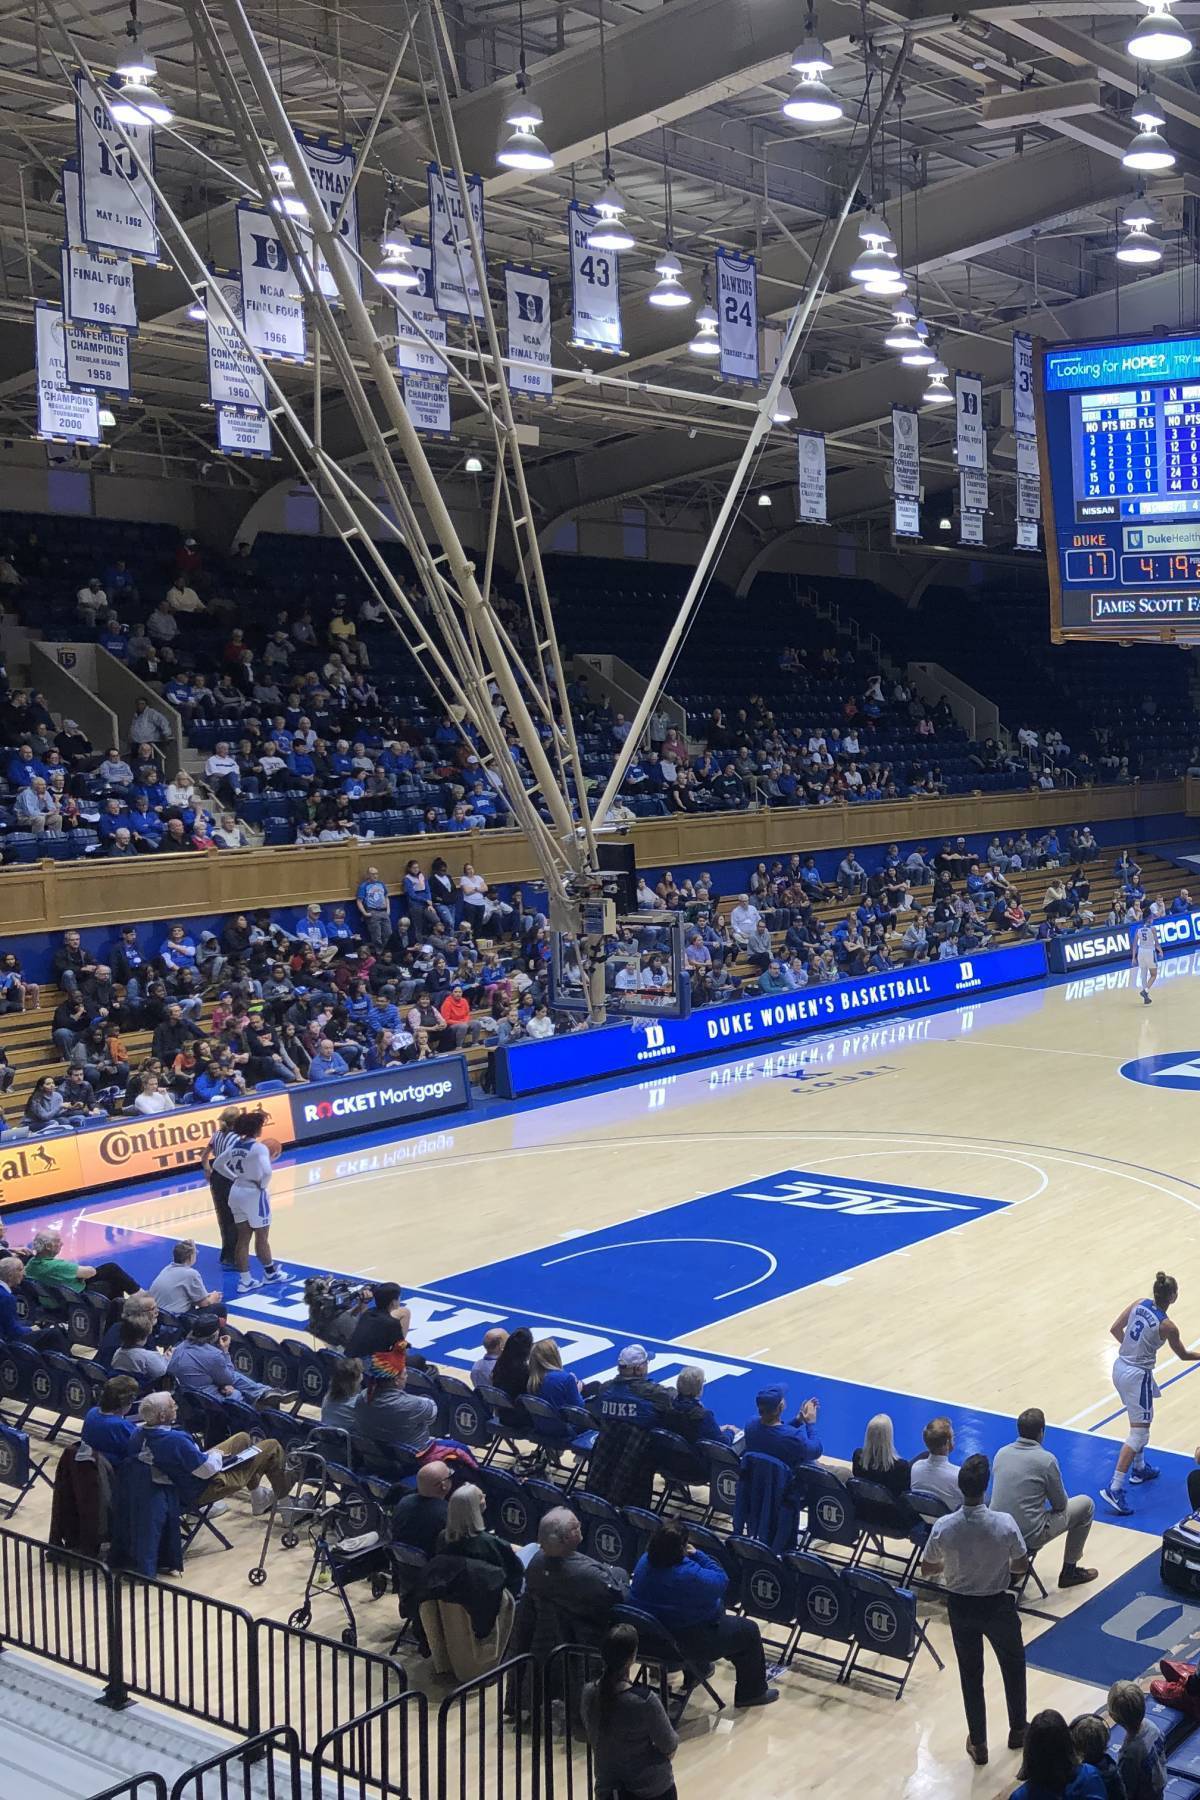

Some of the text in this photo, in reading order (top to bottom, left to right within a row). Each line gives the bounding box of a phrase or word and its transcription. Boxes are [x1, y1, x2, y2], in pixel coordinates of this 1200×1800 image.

[98, 140, 138, 181] 10
[73, 268, 131, 288] FINAL FOUR
[580, 256, 610, 288] 43
[260, 284, 285, 298] NCAA
[722, 274, 753, 296] DAWKINS
[93, 302, 116, 316] 1964
[246, 300, 299, 318] FINAL FOUR
[725, 296, 752, 328] 24
[68, 328, 126, 345] CONFERENCE
[264, 332, 286, 344] 1966
[524, 334, 540, 346] NCAA
[71, 340, 124, 356] CHAMPIONS
[511, 348, 532, 360] FINAL
[1058, 362, 1100, 378] Looking
[1103, 359, 1118, 372] for
[1122, 354, 1165, 370] HOPE?
[1174, 356, 1192, 364] TRY
[88, 368, 112, 381] 1958
[44, 391, 94, 406] CHAMPIONS
[228, 387, 250, 398] 1960
[408, 390, 448, 402] CHAMPIONS
[59, 418, 82, 430] 2000
[1086, 418, 1154, 432] NO PTS REB FLS
[1168, 416, 1180, 426] NO
[1184, 415, 1200, 424] PTS
[236, 434, 256, 444] 2001
[1090, 435, 1095, 445] 3
[1108, 434, 1113, 443] 3
[1126, 433, 1131, 442] 4
[1172, 429, 1177, 439] 3
[1190, 428, 1196, 438] 2
[1090, 447, 1096, 457] 4
[1108, 446, 1114, 456] 2
[1126, 445, 1132, 455] 3
[1170, 442, 1179, 452] 12
[1191, 441, 1196, 450] 0
[1091, 456, 1150, 470] 5 2 2 0
[1171, 455, 1180, 464] 21
[1191, 454, 1197, 463] 6
[1090, 469, 1151, 482] 15 0 0 0
[1171, 468, 1181, 477] 24
[1192, 467, 1197, 476] 3
[1090, 485, 1100, 495] 24
[1110, 484, 1115, 494] 0
[1128, 483, 1133, 493] 0
[1171, 480, 1181, 490] 44
[1192, 479, 1198, 488] 0
[1082, 506, 1114, 515] NISSAN
[1073, 535, 1106, 547] DUKE
[1148, 532, 1200, 544] DukeHealth
[1088, 552, 1107, 576] 17
[1140, 556, 1188, 579] 4:19
[1096, 599, 1136, 616] JAMES
[1138, 597, 1184, 612] SCOTT
[1142, 932, 1148, 941] 5
[1064, 933, 1130, 962] NISSAN
[708, 1012, 752, 1039] DUKE
[761, 995, 834, 1027] WOMEN'S
[841, 976, 931, 1008] BASKETBALL
[791, 1066, 896, 1093] COURT
[304, 1080, 452, 1122] ROCKET Mortgage
[1130, 1320, 1144, 1342] 3
[602, 1400, 637, 1416] DUKE
